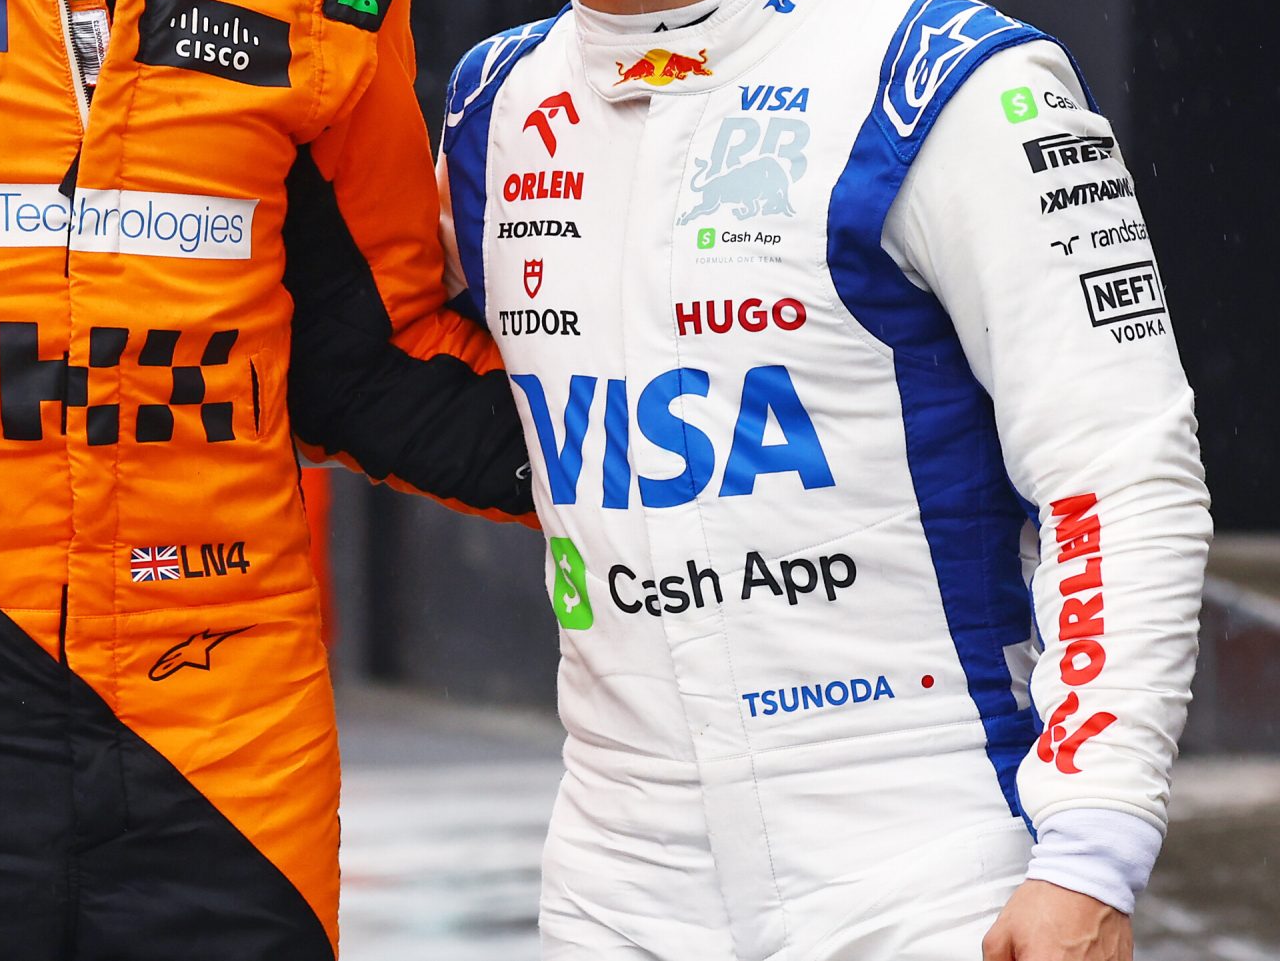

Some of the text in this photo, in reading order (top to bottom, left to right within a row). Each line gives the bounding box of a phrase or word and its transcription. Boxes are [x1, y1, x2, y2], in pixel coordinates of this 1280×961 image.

[737, 84, 811, 113] VISA
[1043, 91, 1080, 110] Cas
[1023, 133, 1115, 174] PIRE
[503, 169, 585, 203] ORLEN
[496, 219, 582, 240] HONDA
[721, 230, 782, 245] Cash App
[1090, 218, 1150, 249] randsta
[695, 256, 734, 265] FORMULA
[758, 256, 783, 264] TEAM
[1092, 273, 1156, 313] NEFT
[498, 308, 581, 336] TUDOR
[675, 296, 808, 337] HUGO
[1110, 317, 1167, 344] VODKA
[510, 364, 836, 511] VISA
[182, 541, 251, 578] LN4
[608, 550, 858, 616] Cash App
[1049, 492, 1107, 687] ORLEN
[742, 674, 896, 718] TSUNODA
